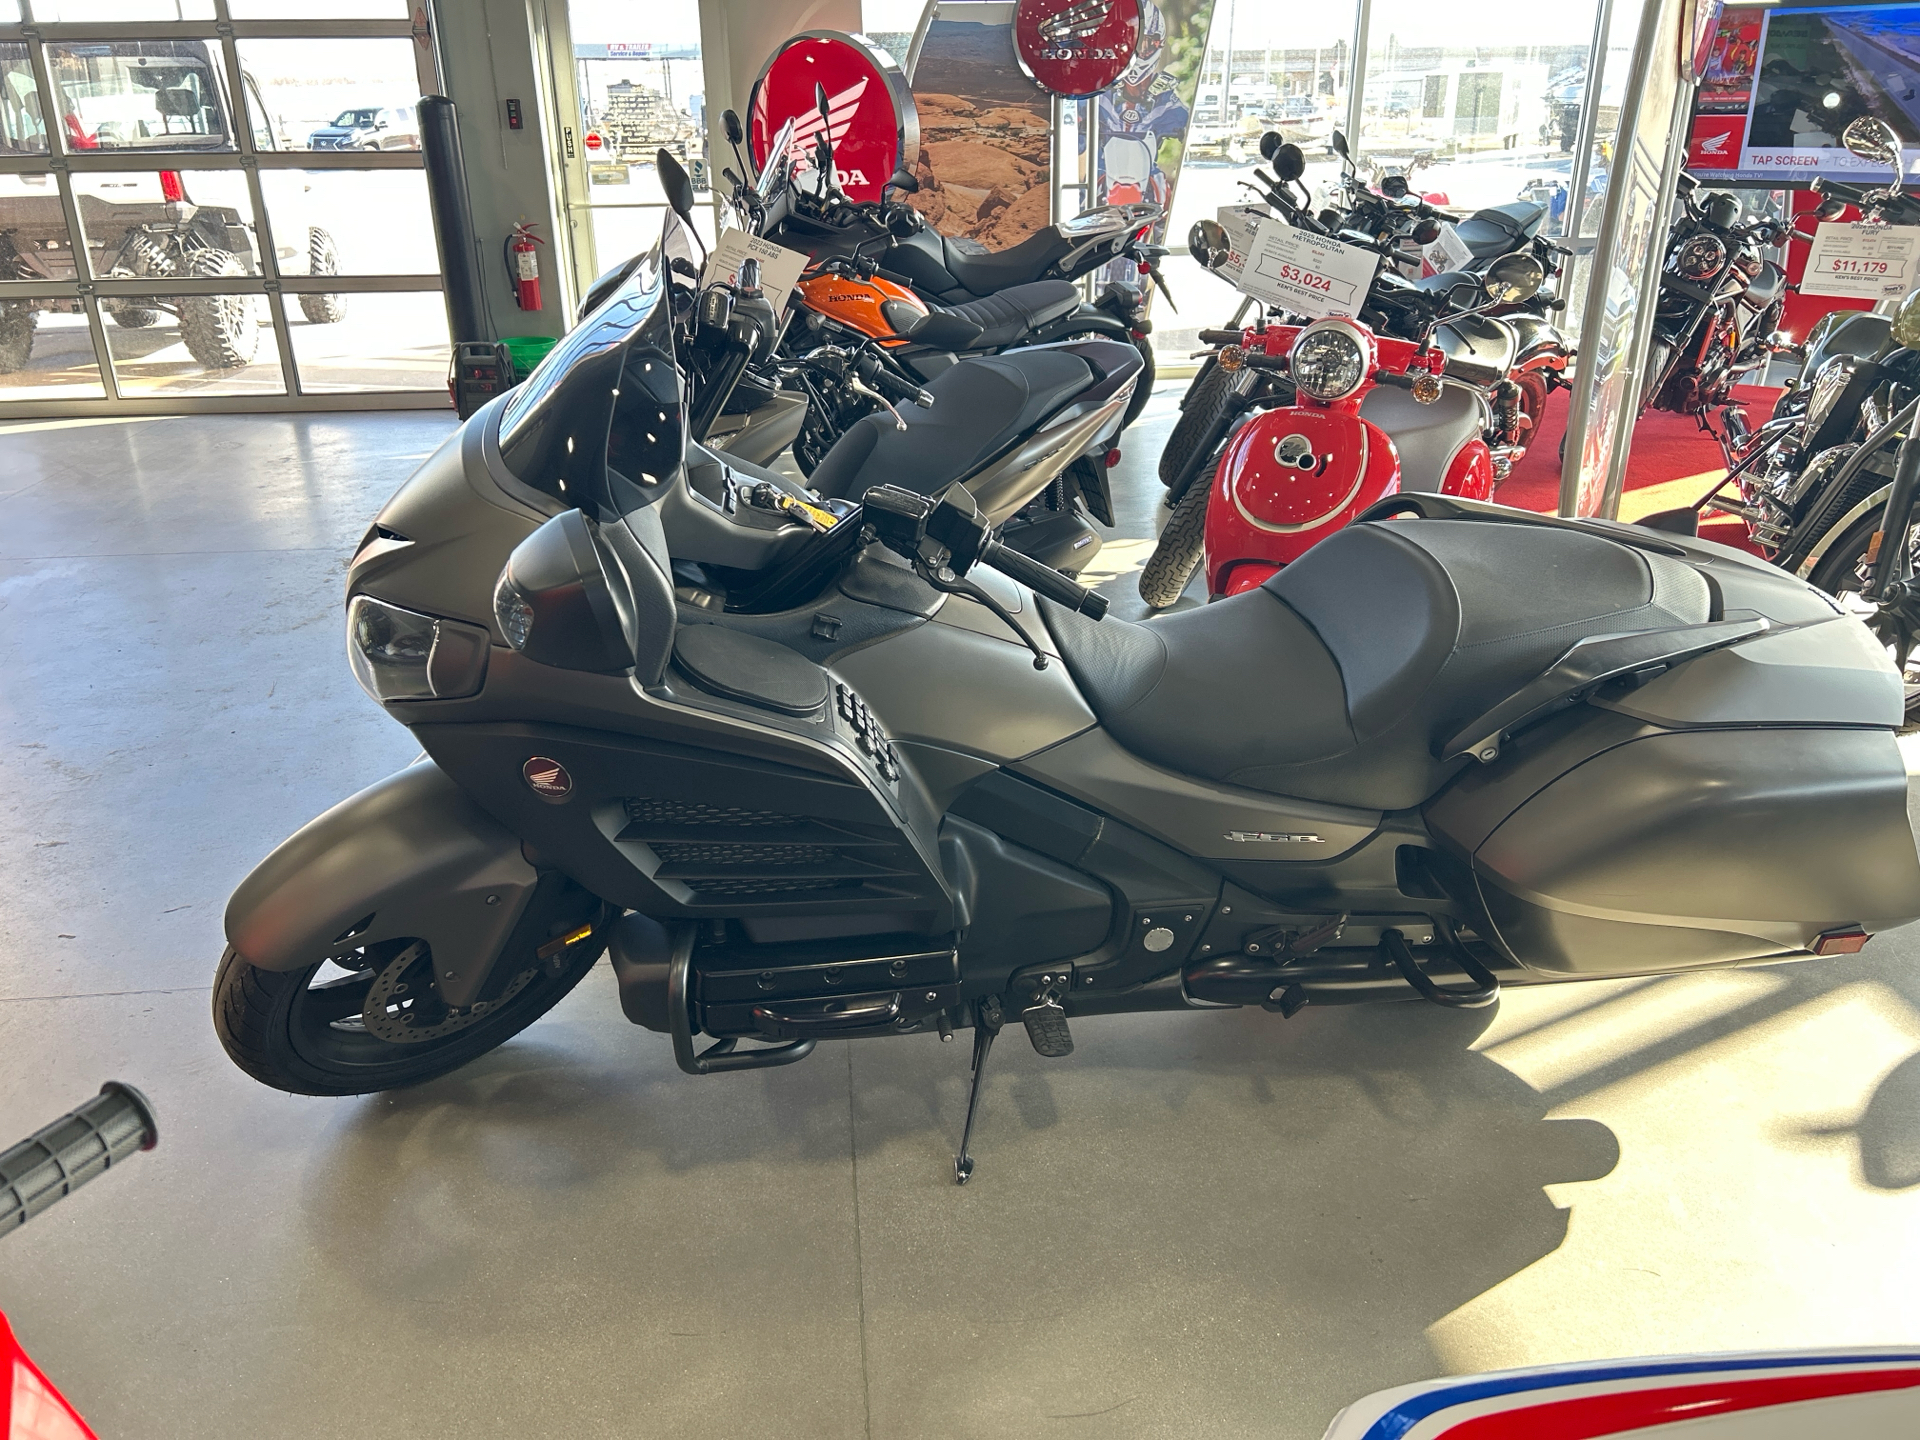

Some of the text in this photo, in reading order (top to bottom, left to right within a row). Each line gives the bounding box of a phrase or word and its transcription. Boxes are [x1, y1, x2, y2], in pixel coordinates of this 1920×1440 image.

[1041, 48, 1118, 60] HONDA
[566, 128, 574, 153] PUSH
[1752, 155, 1773, 166] TAP
[1776, 156, 1819, 166] SCREEN
[1834, 156, 1847, 167] TO
[750, 238, 782, 254] 2023 HONDA
[1292, 234, 1345, 255] METROPOLITAN
[1299, 230, 1341, 248] 2025 HONDA
[768, 251, 780, 260] ABS
[1832, 259, 1888, 274] $11,179
[1280, 264, 1332, 293] $3,024
[828, 294, 872, 302] HONDA
[1277, 283, 1325, 303] KEN'S BEST PRICE
[1289, 411, 1327, 420] HONDA
[532, 783, 567, 791] HONDA
